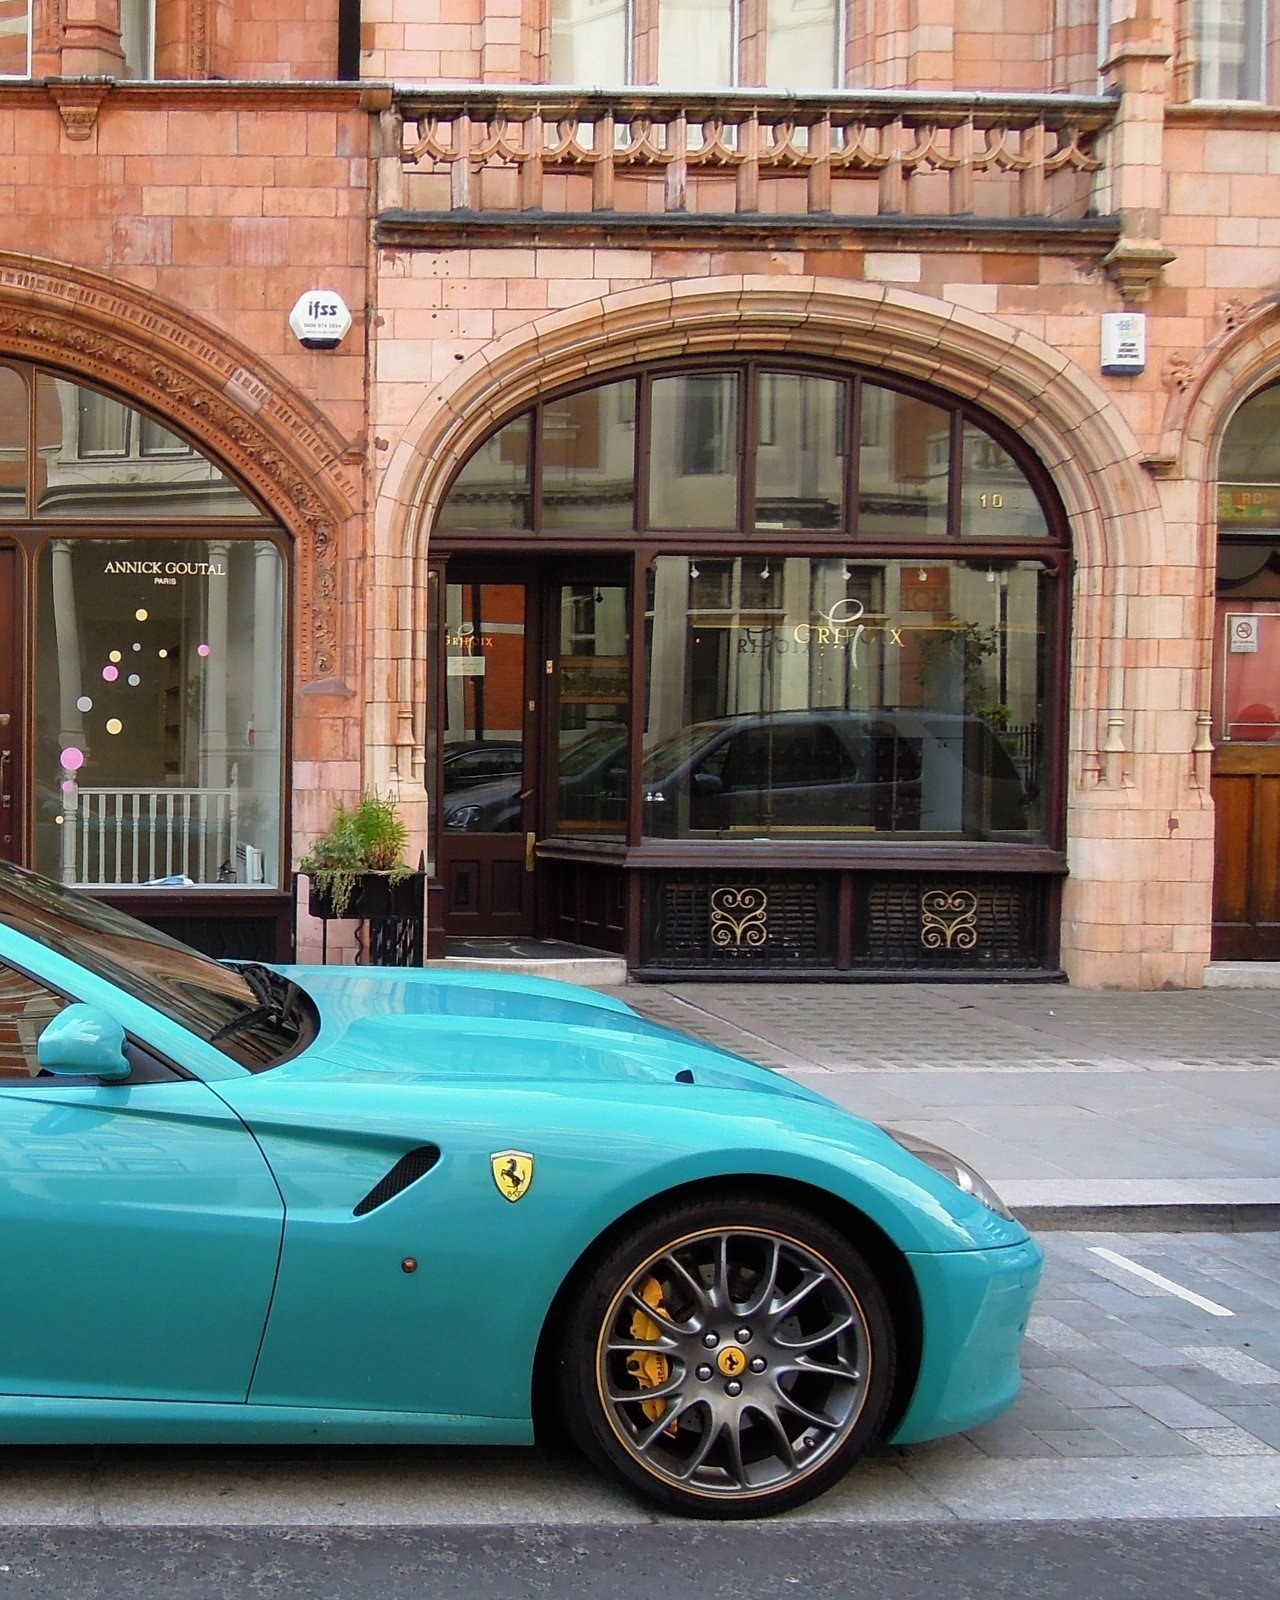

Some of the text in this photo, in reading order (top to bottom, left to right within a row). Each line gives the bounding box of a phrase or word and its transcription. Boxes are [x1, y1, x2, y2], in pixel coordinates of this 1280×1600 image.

[308, 301, 338, 320] ifss
[980, 493, 1003, 508] 10
[104, 561, 227, 576] ANNICK GOUTAL
[153, 577, 177, 586] PARIS
